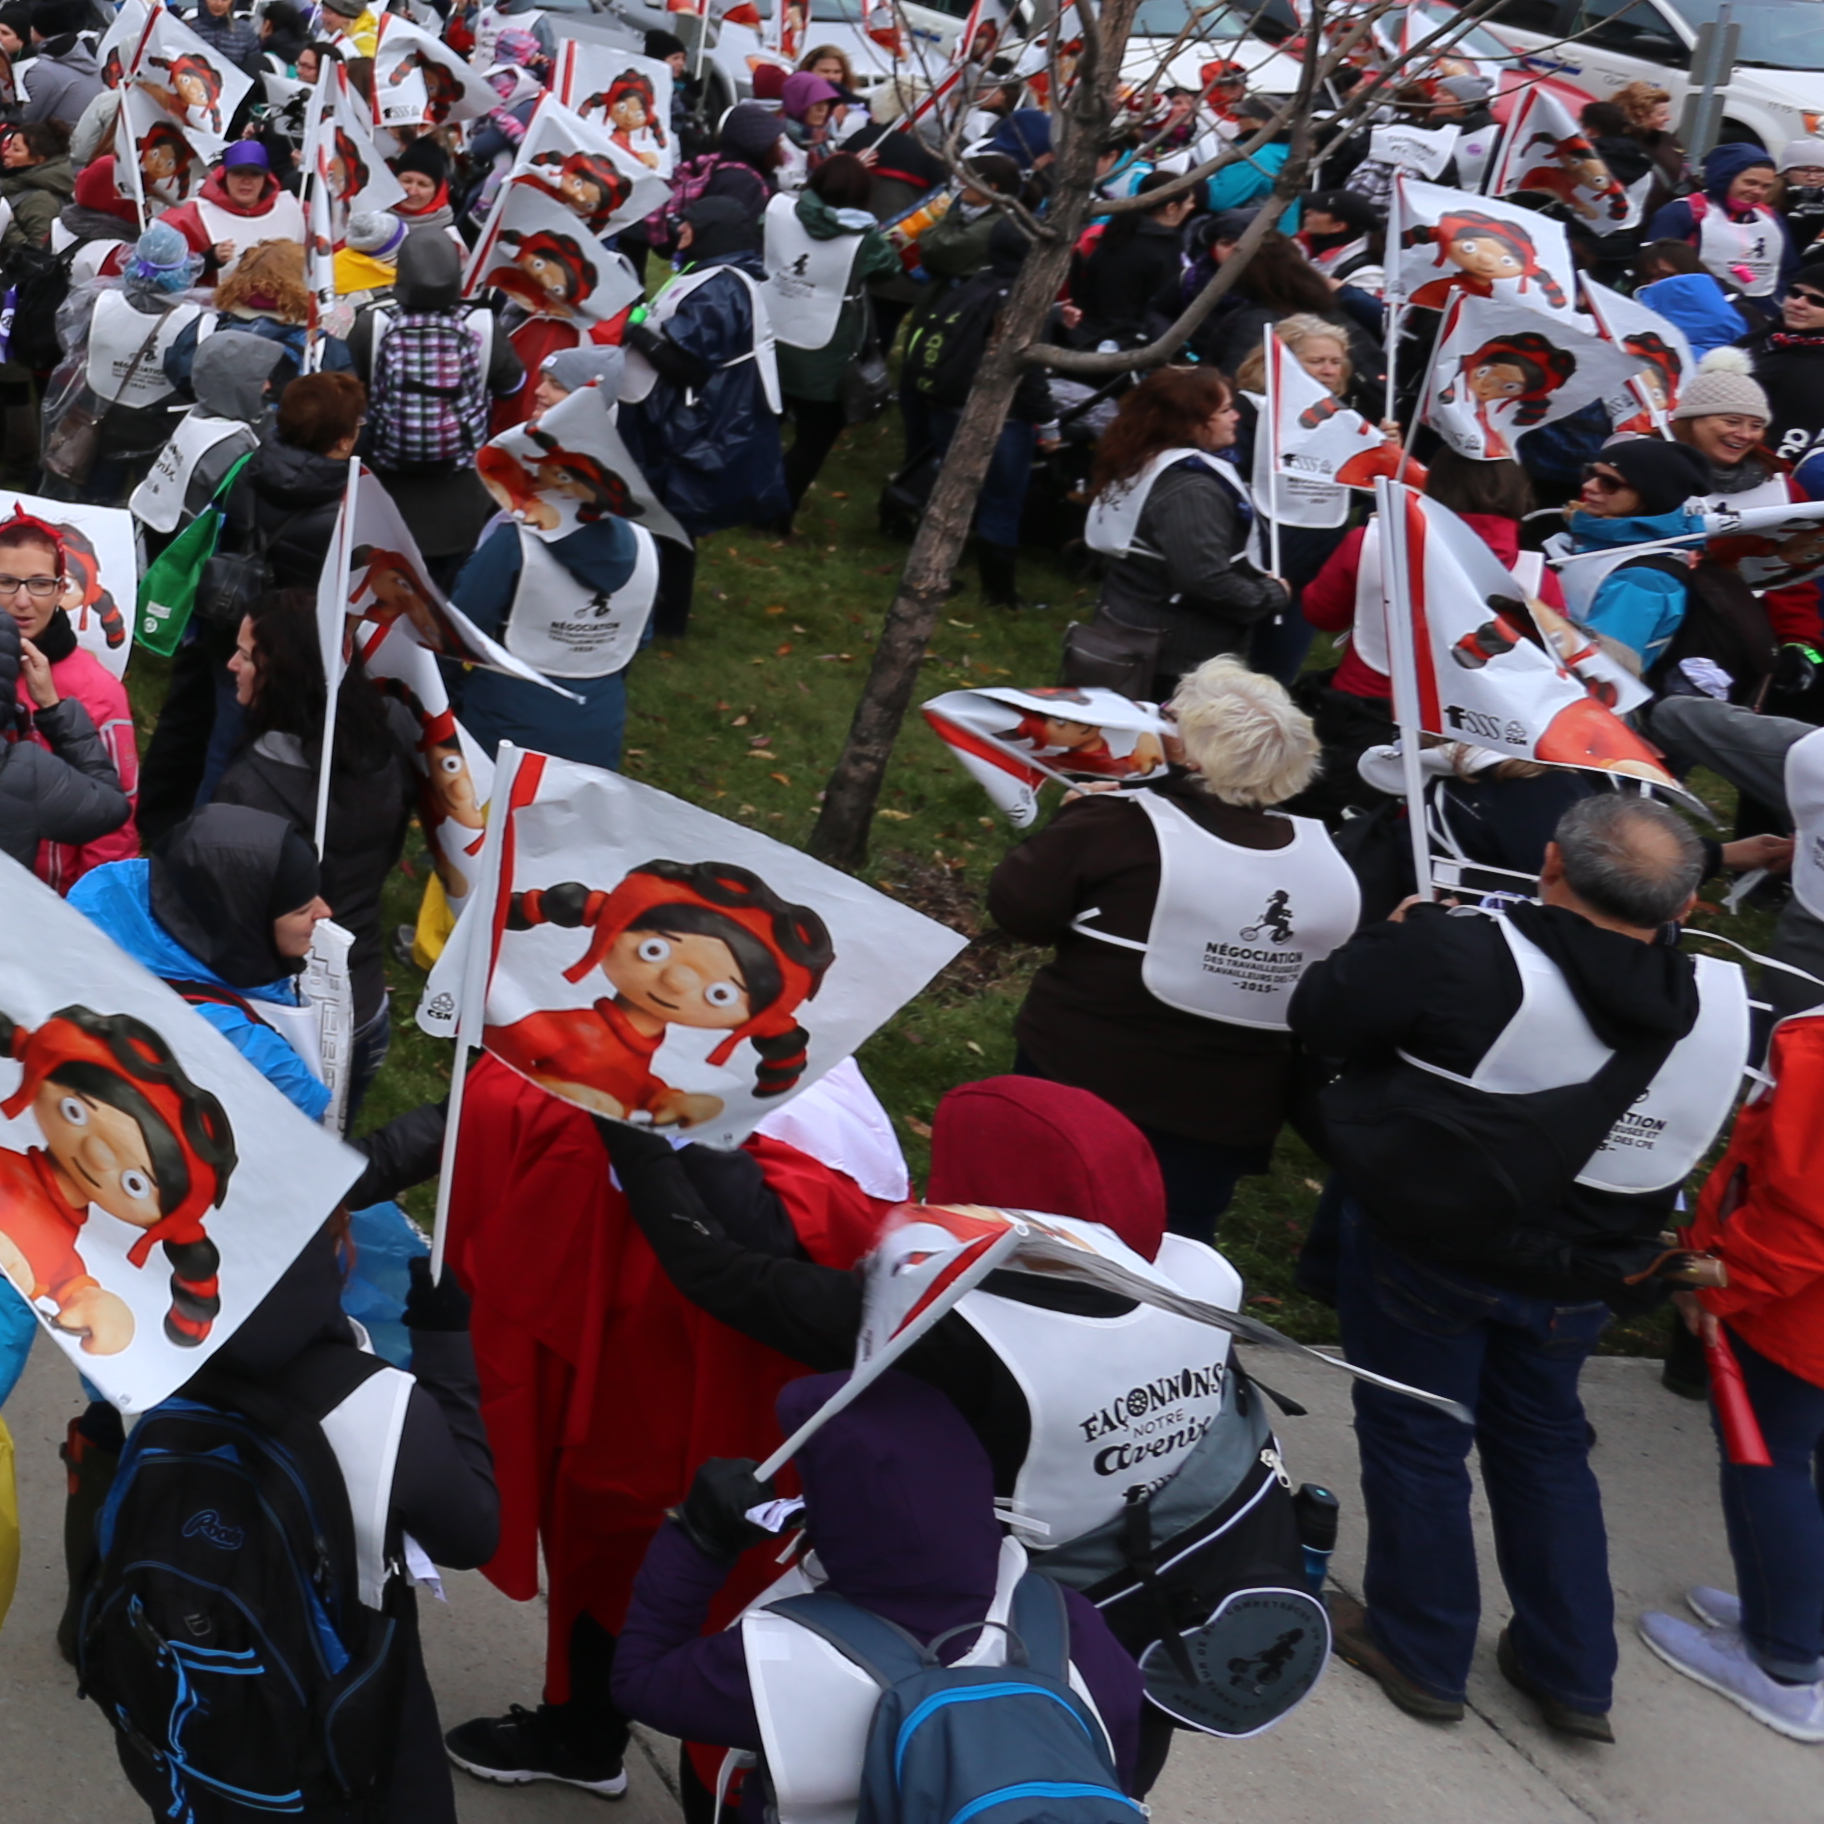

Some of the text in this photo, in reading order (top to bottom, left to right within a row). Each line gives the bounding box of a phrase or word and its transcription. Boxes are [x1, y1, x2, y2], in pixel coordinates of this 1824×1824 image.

[1205, 942, 1303, 965] NÉGOCIATION
[1078, 1362, 1225, 1444] FAÇONNONS
[1133, 1408, 1185, 1438] NOTRE
